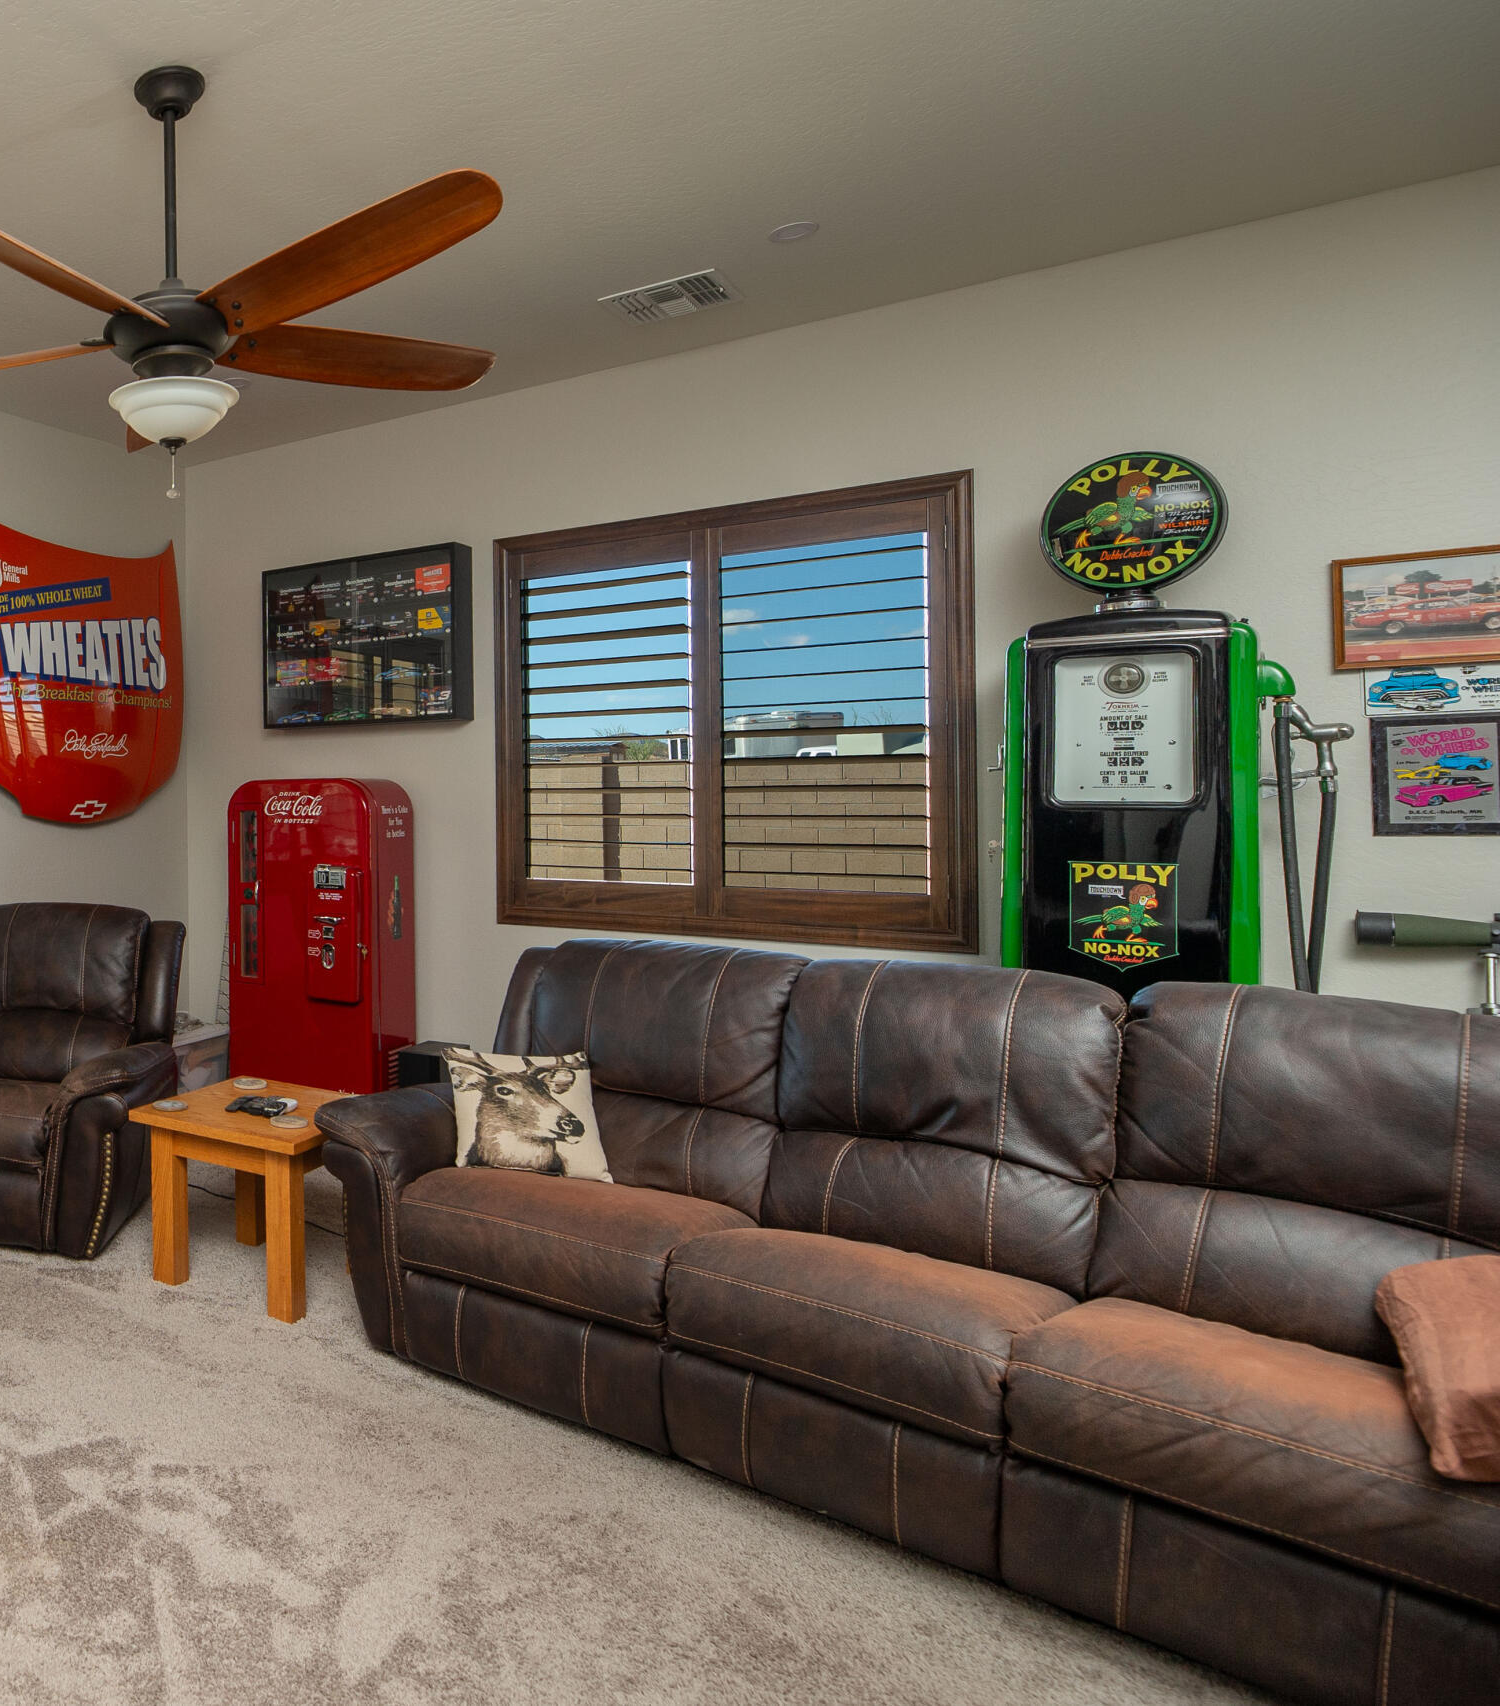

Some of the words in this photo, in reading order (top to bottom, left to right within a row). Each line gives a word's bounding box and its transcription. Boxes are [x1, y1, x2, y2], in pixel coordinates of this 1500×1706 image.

[1067, 459, 1192, 497] POLLY
[1157, 482, 1199, 493] TOUCHDOWN
[1154, 499, 1211, 513] NO-NOX
[2, 561, 29, 576] General
[1064, 539, 1197, 584] NO-NOX
[3, 571, 21, 584] Mills
[10, 594, 37, 611] 100%
[36, 588, 73, 607] WHOLE
[72, 584, 103, 601] WHEAT
[35, 683, 94, 703] Breakfast
[97, 690, 112, 703] of
[113, 689, 173, 710] Champions!
[1405, 726, 1476, 748] WORLD
[1417, 736, 1490, 759] WHEELS
[264, 794, 323, 816] Coca-Cola
[1071, 863, 1176, 887] POLLY
[1083, 941, 1160, 958] NO-NOX
